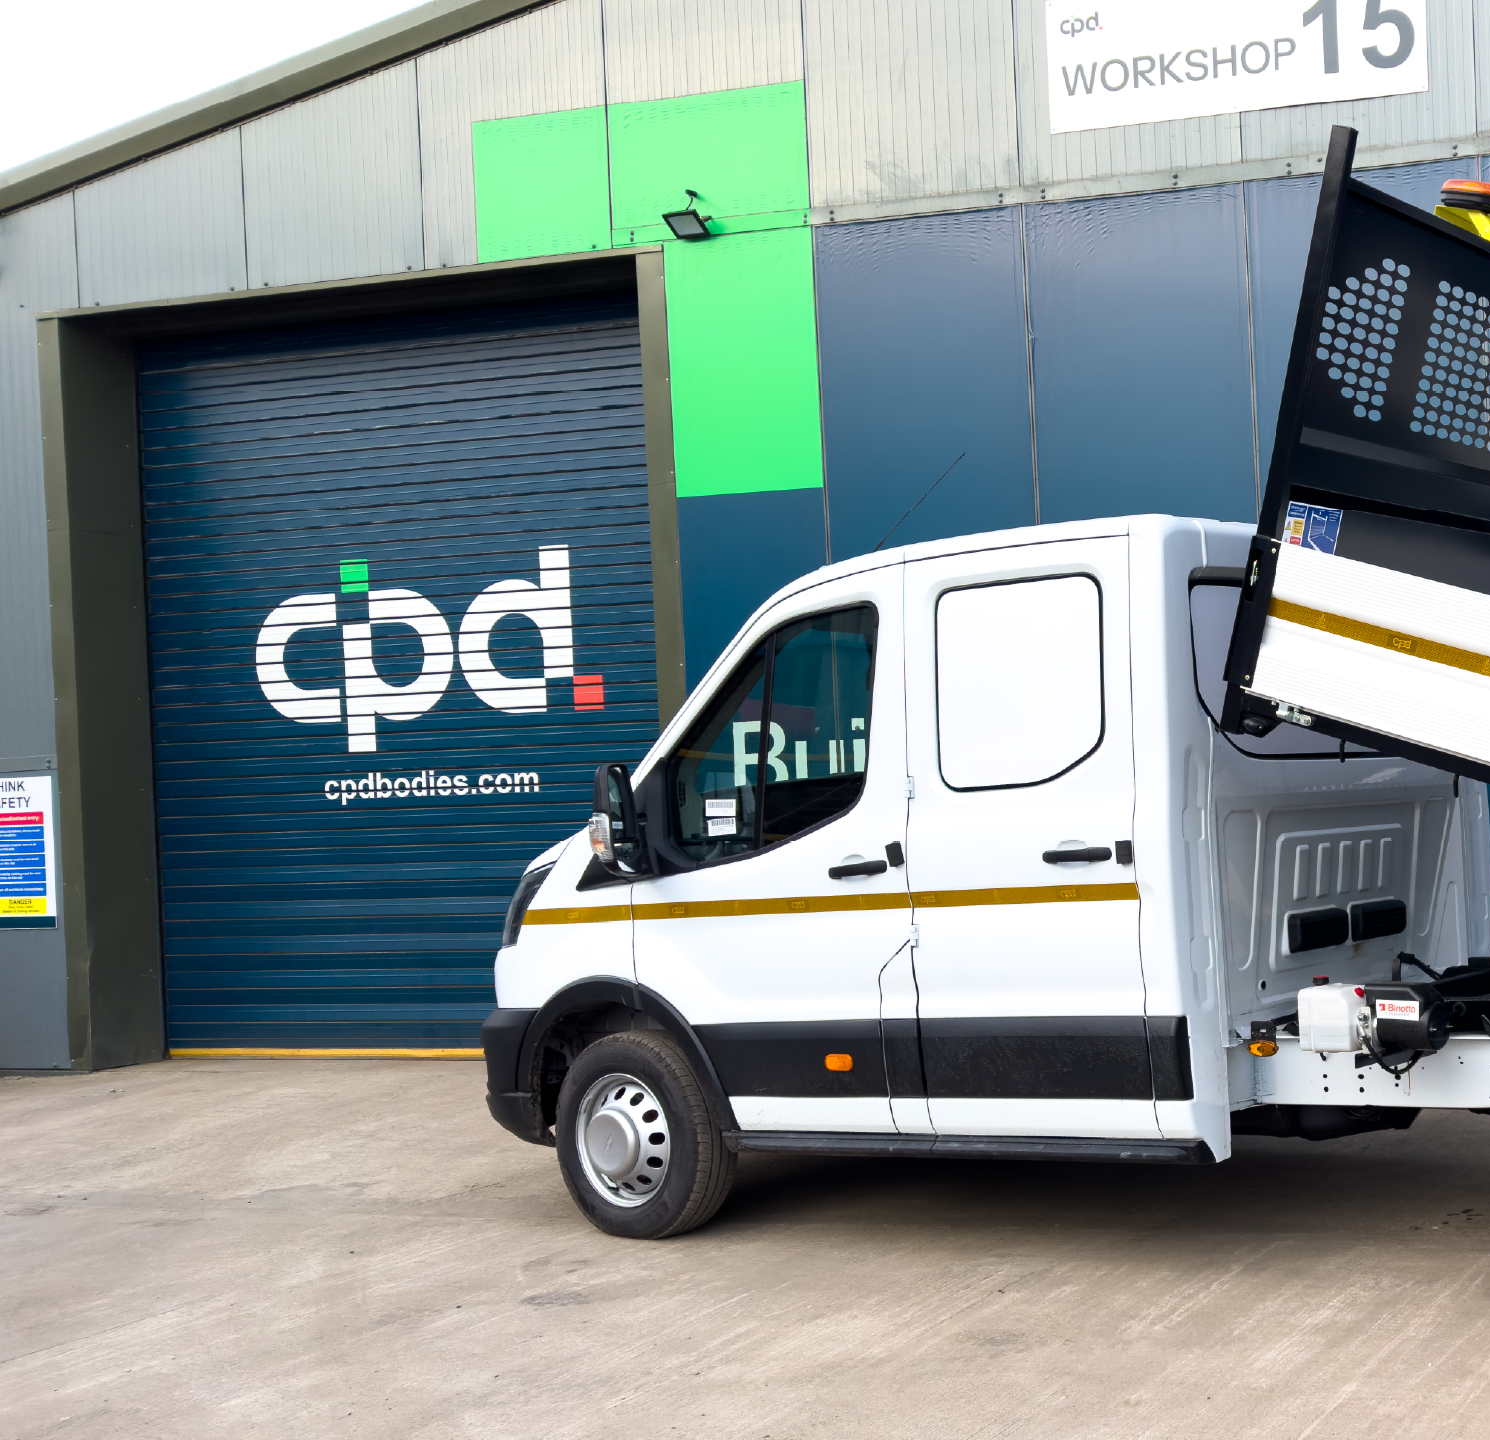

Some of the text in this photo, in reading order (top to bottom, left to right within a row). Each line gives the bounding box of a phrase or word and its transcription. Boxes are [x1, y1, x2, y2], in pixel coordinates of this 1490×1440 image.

[1062, 0, 1415, 96] WORKSHOP 15
[0, 780, 26, 792] HINK
[324, 770, 540, 806] cpdbodies.com
[0, 796, 31, 808] FETY
[1388, 1003, 1416, 1013] Binotto
